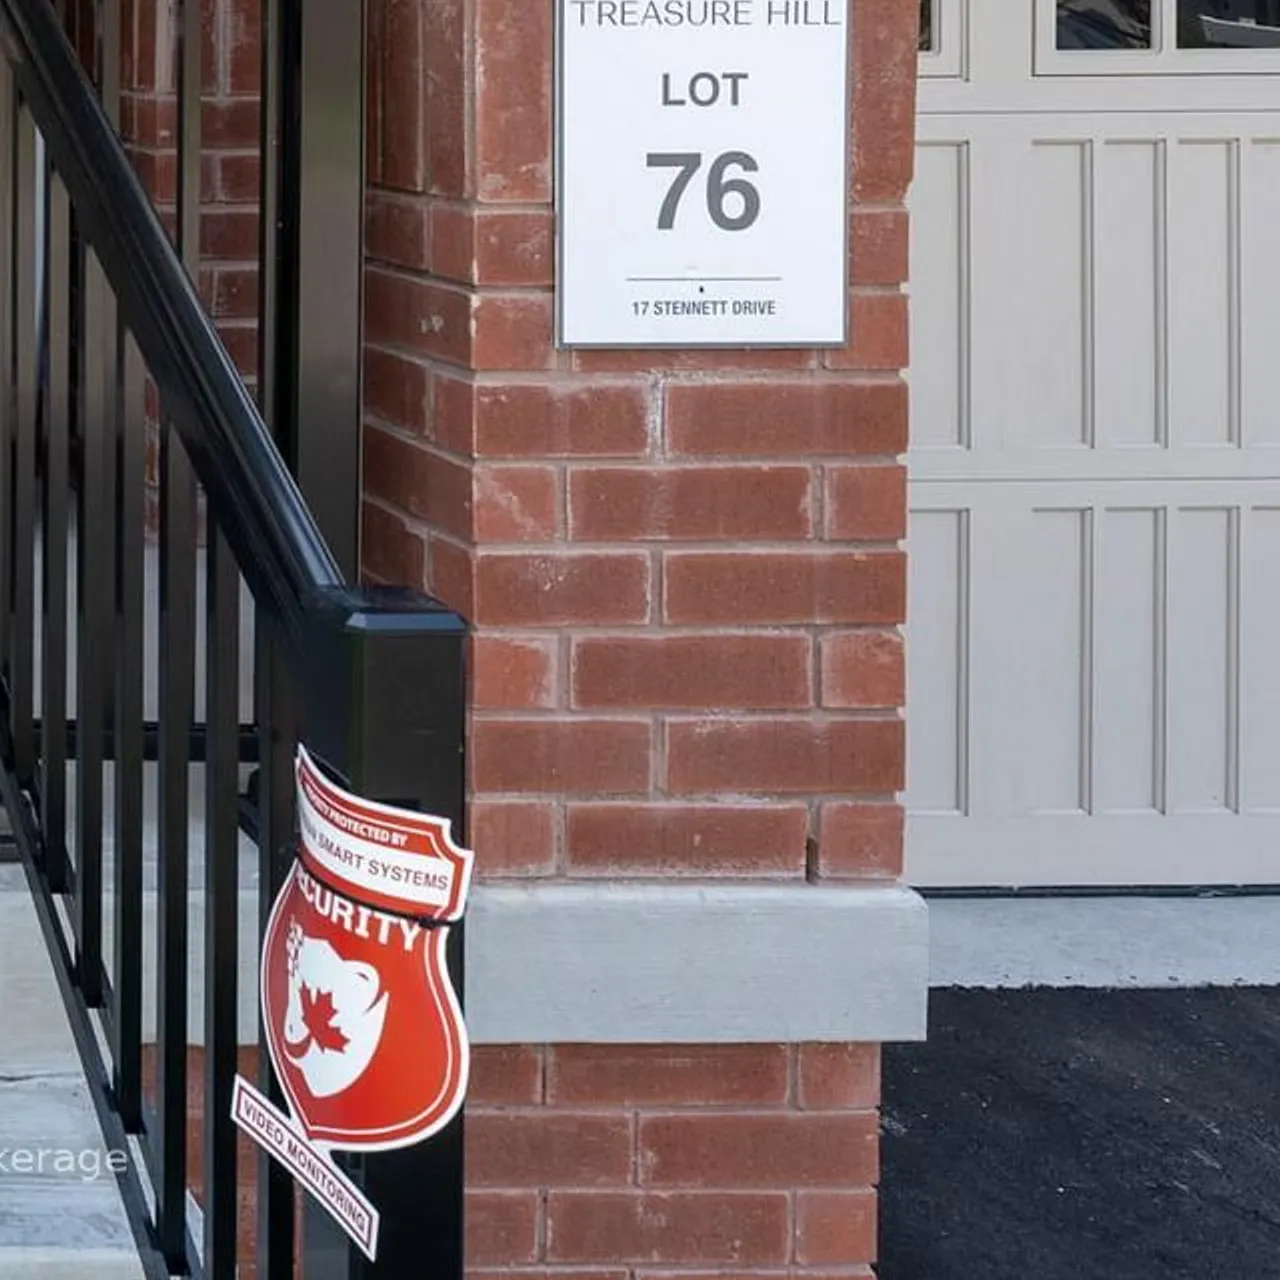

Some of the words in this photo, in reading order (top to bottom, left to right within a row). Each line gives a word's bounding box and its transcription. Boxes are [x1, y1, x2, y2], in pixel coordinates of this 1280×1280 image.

[571, 0, 754, 27] TREASURE
[766, 0, 842, 26] HILL
[661, 72, 749, 107] LOT
[645, 151, 761, 232] 76
[632, 300, 649, 316] 17
[654, 300, 728, 316] STENNETT
[732, 300, 776, 316] DRIVE
[329, 808, 389, 842] PROTECTED
[318, 832, 364, 869] SMART
[368, 859, 450, 891] SYSTEMS
[244, 1098, 285, 1144] VIDEO
[286, 1141, 366, 1231] MONITORING
